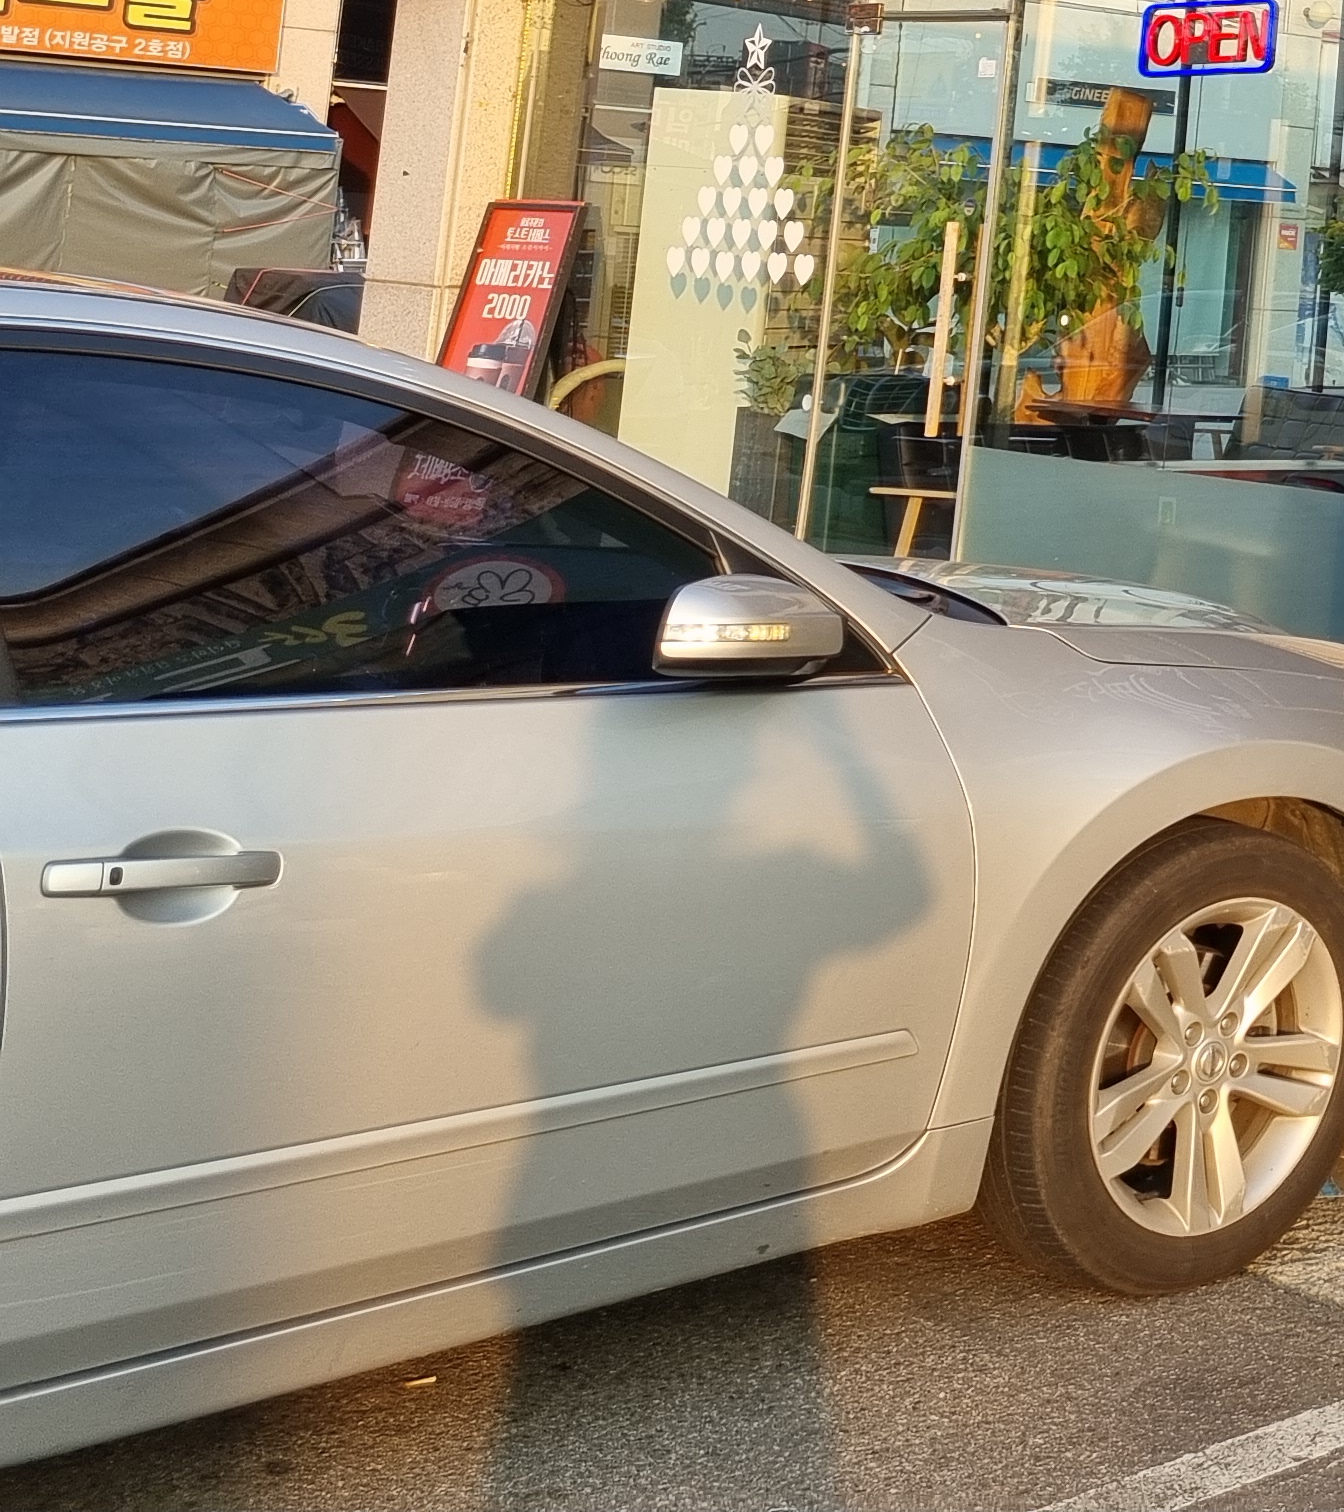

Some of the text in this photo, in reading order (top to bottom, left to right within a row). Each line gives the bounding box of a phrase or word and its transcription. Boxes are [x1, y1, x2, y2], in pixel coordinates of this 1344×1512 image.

[45, 28, 129, 54] (지원공구
[134, 39, 192, 60] 2호점)
[1146, 9, 1270, 67] OPEN
[475, 258, 555, 289] 아메리카노
[481, 292, 532, 320] 2000
